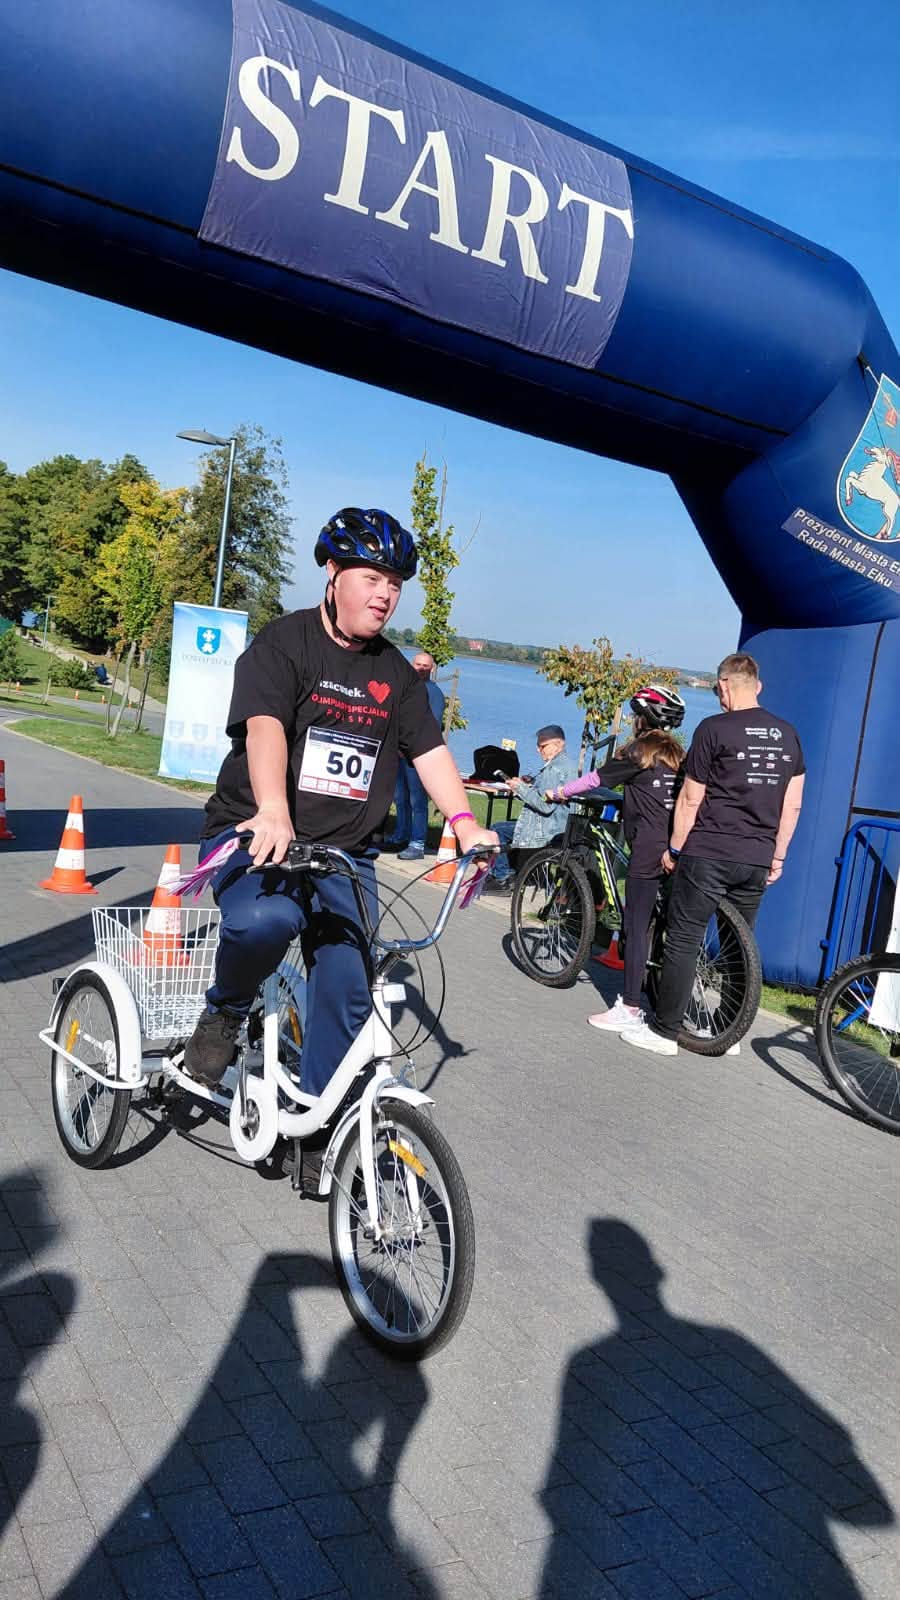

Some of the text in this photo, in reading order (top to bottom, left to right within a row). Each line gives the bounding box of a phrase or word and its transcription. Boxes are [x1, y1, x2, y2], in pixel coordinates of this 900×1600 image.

[226, 55, 635, 303] START
[794, 508, 852, 548] Prezydent
[852, 542, 889, 568] Miasta
[797, 529, 893, 588] Rada Miasta Ełku
[326, 750, 363, 779] 50
